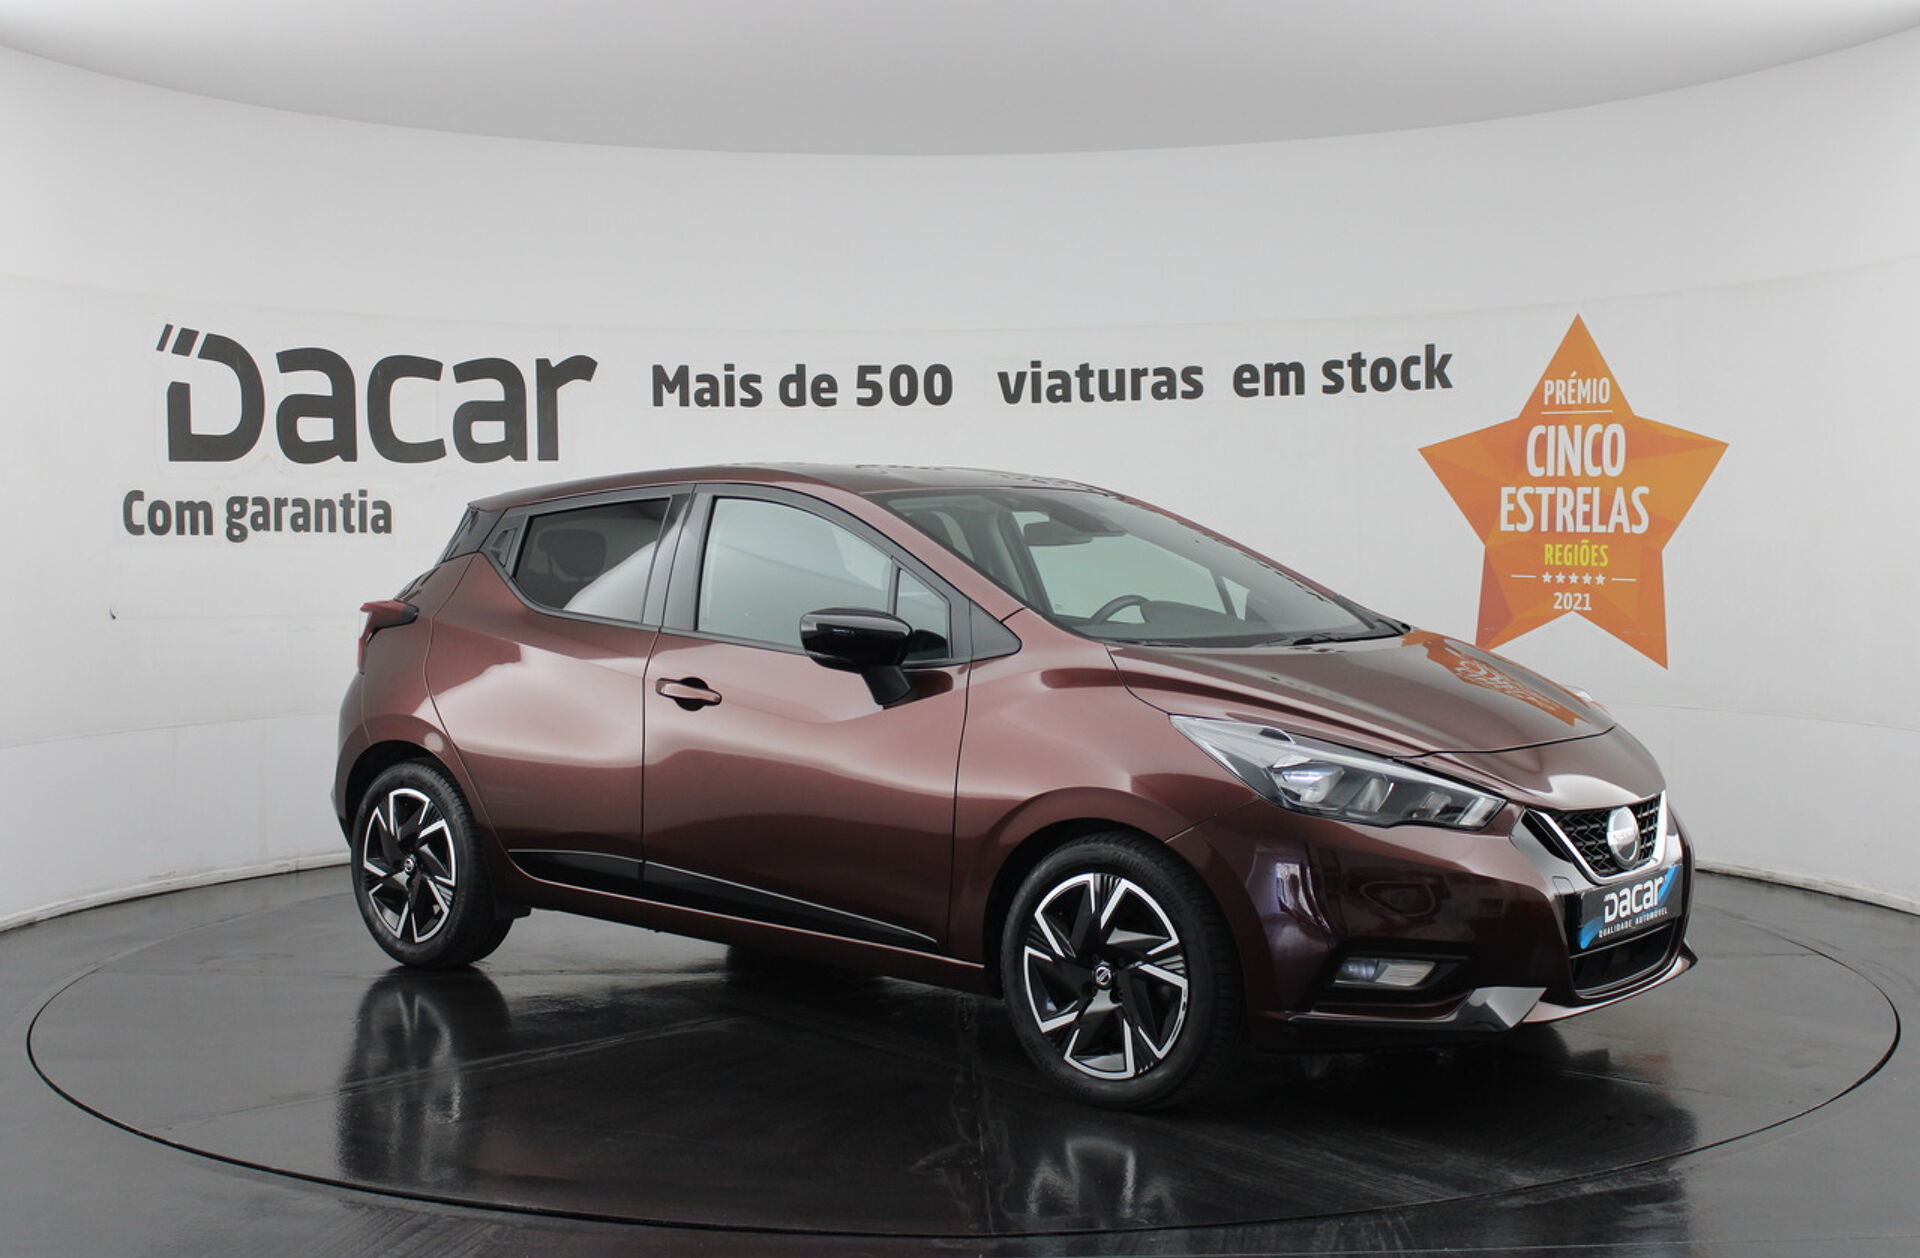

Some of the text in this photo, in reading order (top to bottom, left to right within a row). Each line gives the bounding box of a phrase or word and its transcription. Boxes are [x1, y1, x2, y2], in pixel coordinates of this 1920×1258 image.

[157, 324, 598, 464] Dacar
[652, 343, 1454, 408] Mais de 500 viaturas em stock
[1543, 371, 1611, 405] PRÉMIO
[1526, 423, 1627, 477] CINCO
[123, 489, 392, 543] Com garantia
[1499, 485, 1650, 534] ESTRELAS
[1543, 539, 1609, 567] REGIÕES
[1552, 592, 1593, 611] 2021
[1604, 877, 1664, 922] Dacar
